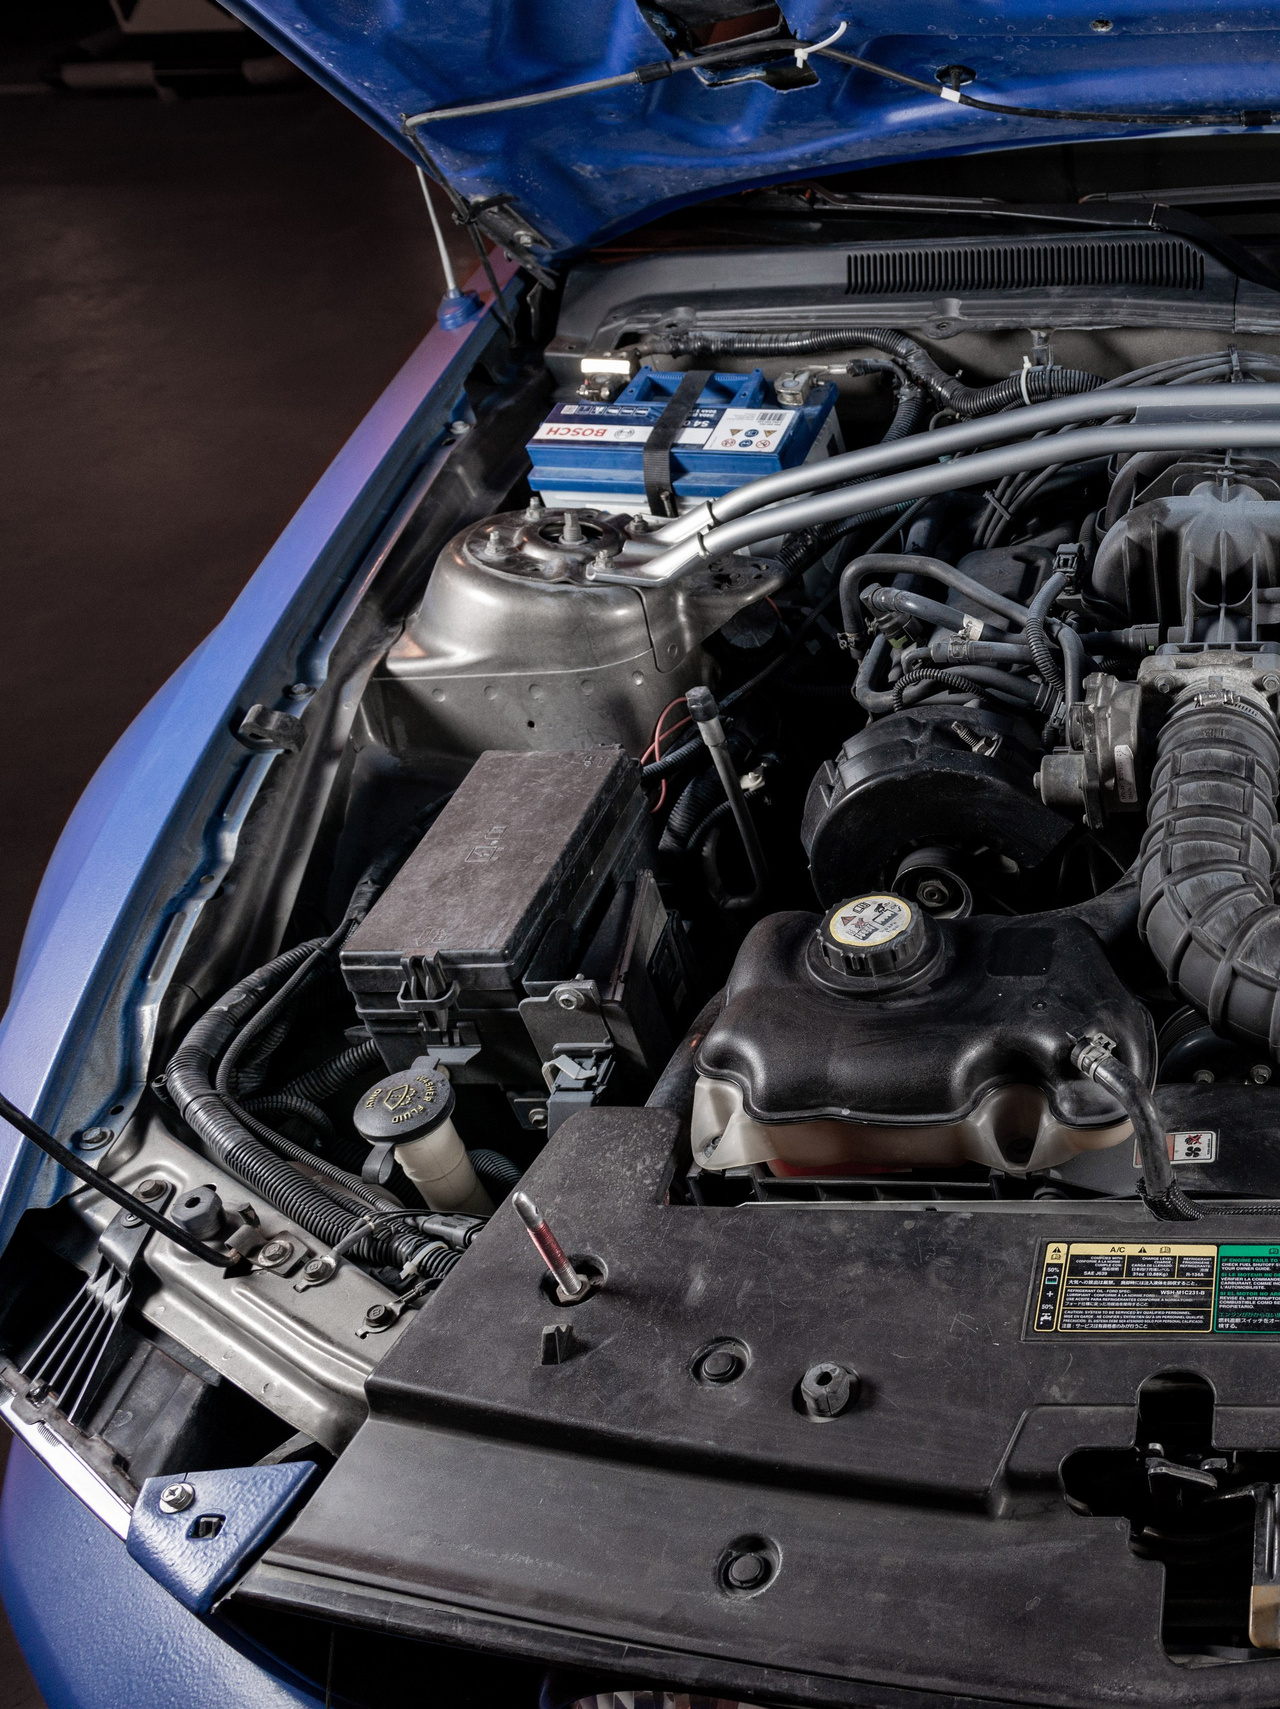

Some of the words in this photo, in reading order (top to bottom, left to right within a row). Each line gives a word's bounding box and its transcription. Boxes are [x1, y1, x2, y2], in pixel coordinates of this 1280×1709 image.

[545, 426, 608, 437] BOSCH
[692, 419, 709, 427] S4
[417, 1075, 434, 1102] WASHER
[366, 1088, 382, 1109] ONLY
[392, 1104, 424, 1123] FLUID
